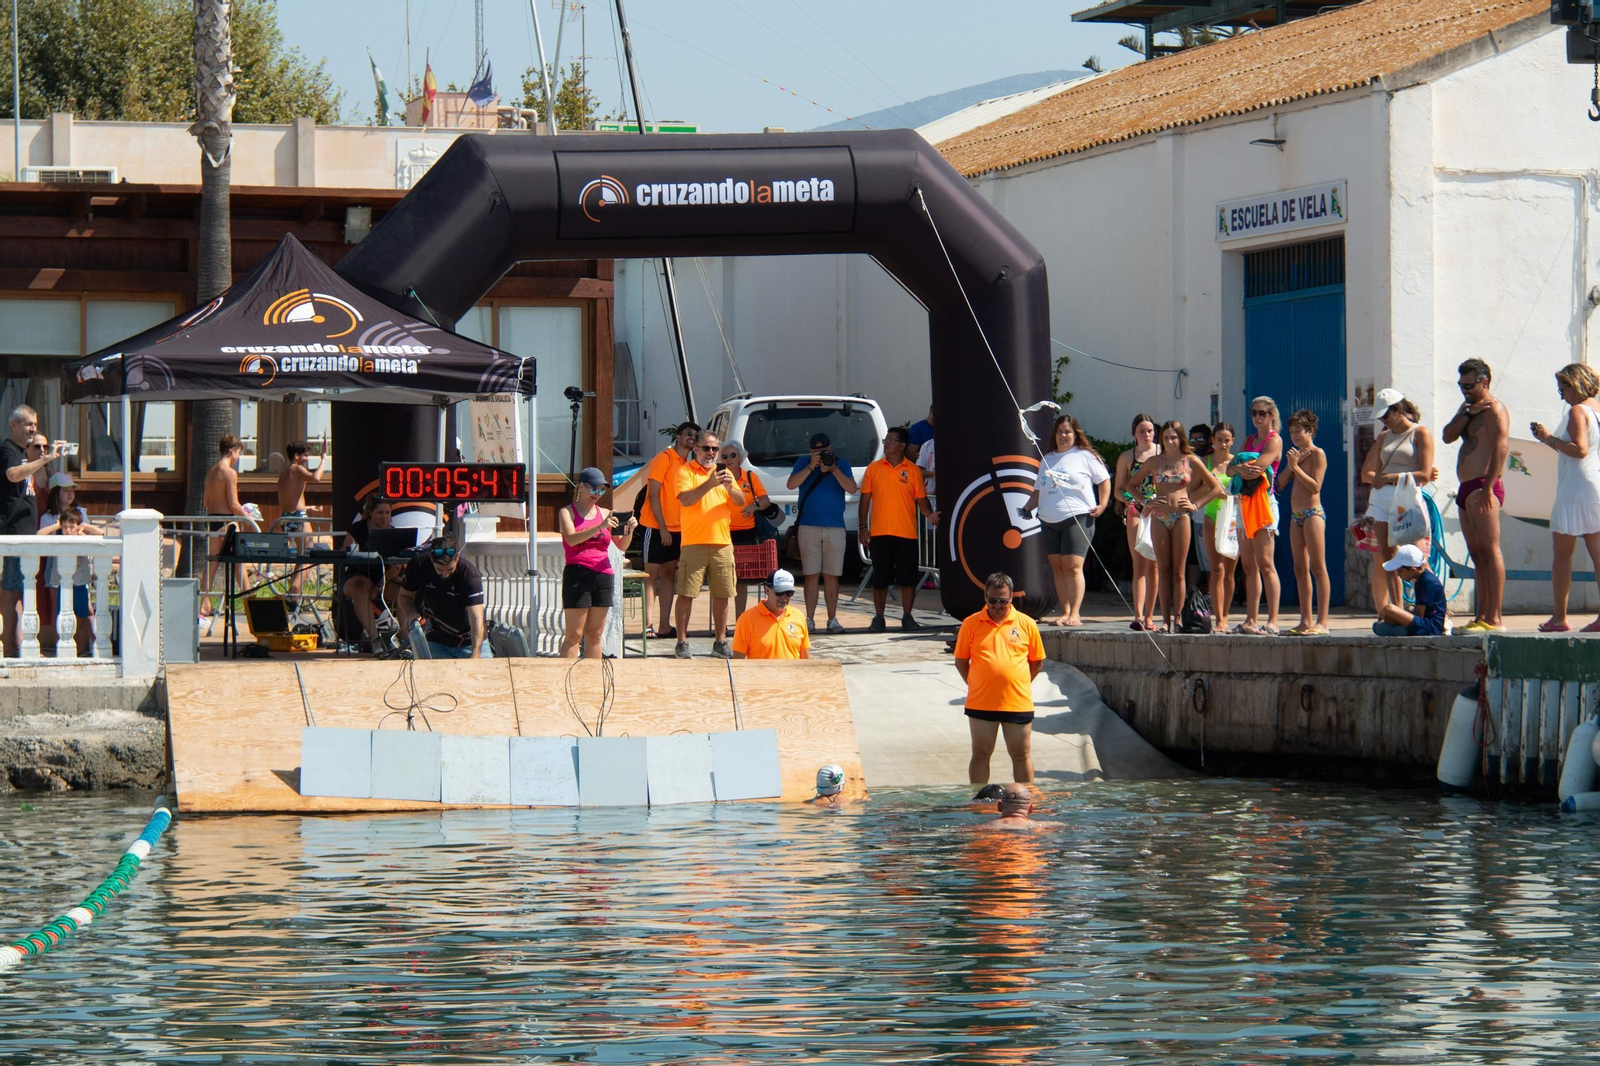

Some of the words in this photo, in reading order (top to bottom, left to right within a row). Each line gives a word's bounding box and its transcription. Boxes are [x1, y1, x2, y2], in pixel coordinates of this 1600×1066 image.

[636, 178, 835, 206] cruzandolameta
[1231, 202, 1279, 231] ESCUELA
[1282, 199, 1296, 223] DE
[1299, 194, 1327, 220] VELA
[220, 343, 431, 355] cruzandolameta
[280, 355, 419, 374] cruzandolameta
[386, 467, 517, 498] 00:05:41
